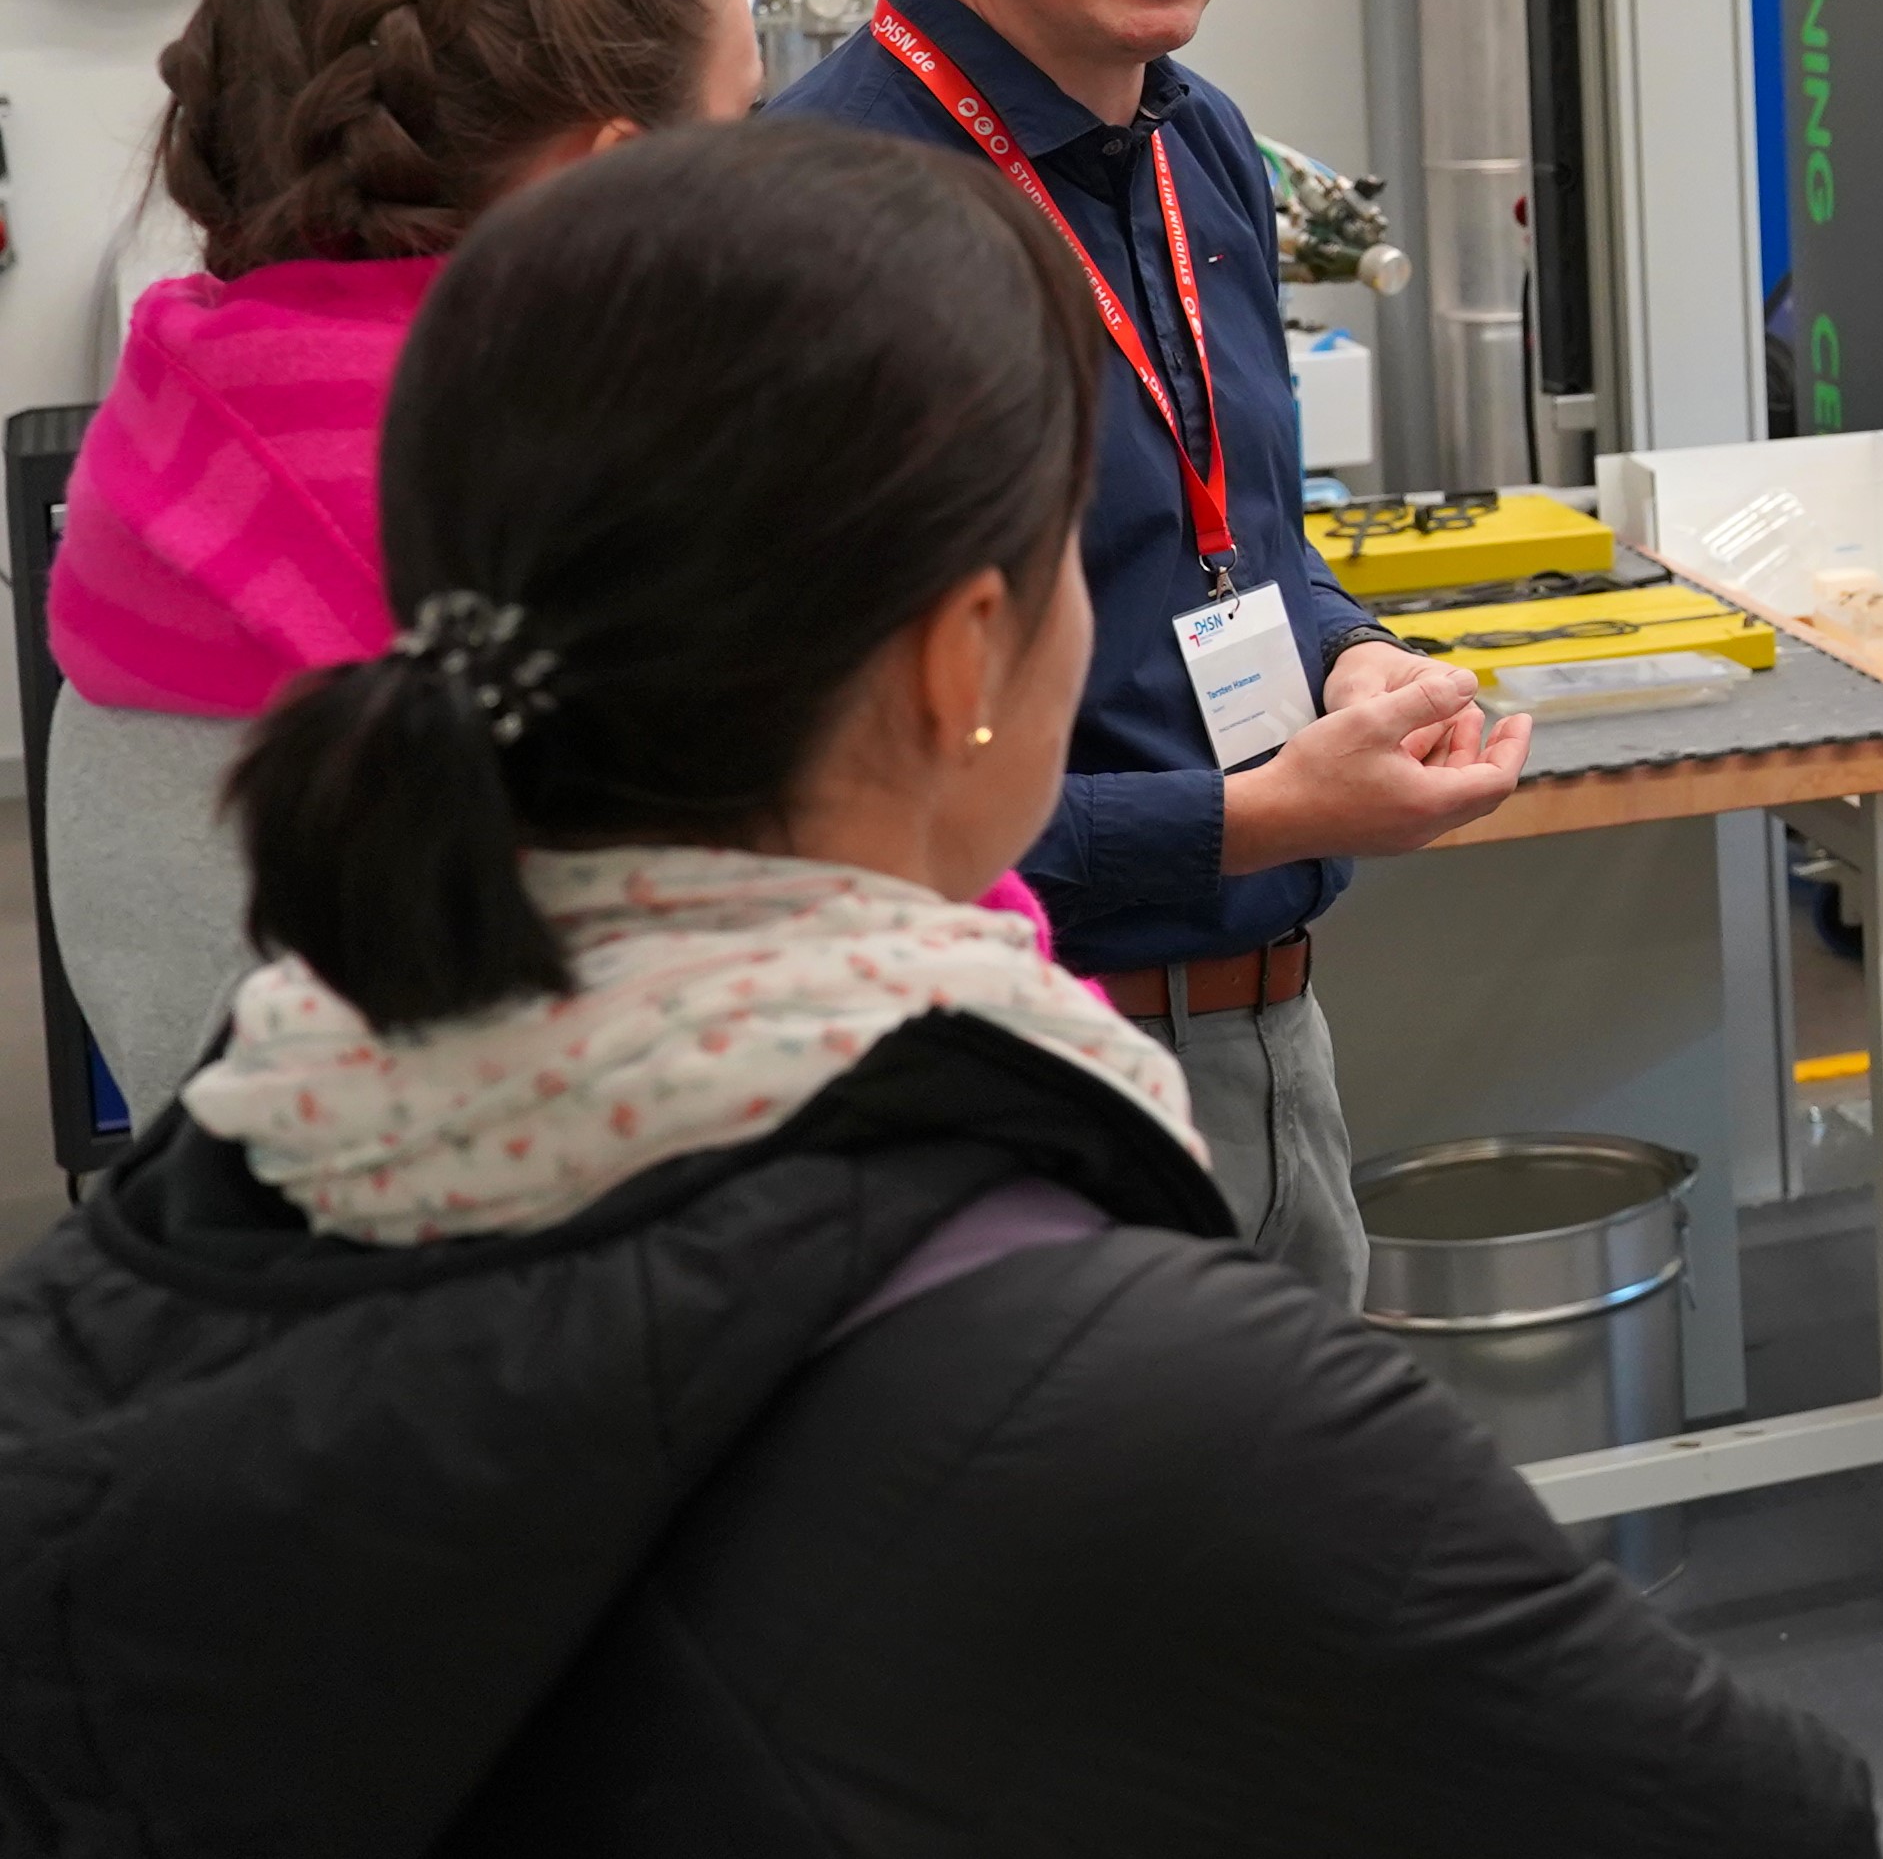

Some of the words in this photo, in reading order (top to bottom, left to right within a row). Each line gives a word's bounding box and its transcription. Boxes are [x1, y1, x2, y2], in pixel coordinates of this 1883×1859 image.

[879, 14, 935, 73] DHSN.de
[1162, 177, 1176, 207] MIT
[1168, 210, 1192, 285] STUDIUM
[1811, 311, 1842, 431] CE
[1195, 613, 1223, 636] DHSN
[1207, 684, 1233, 700] Torsten
[1234, 673, 1262, 689] Hamann
